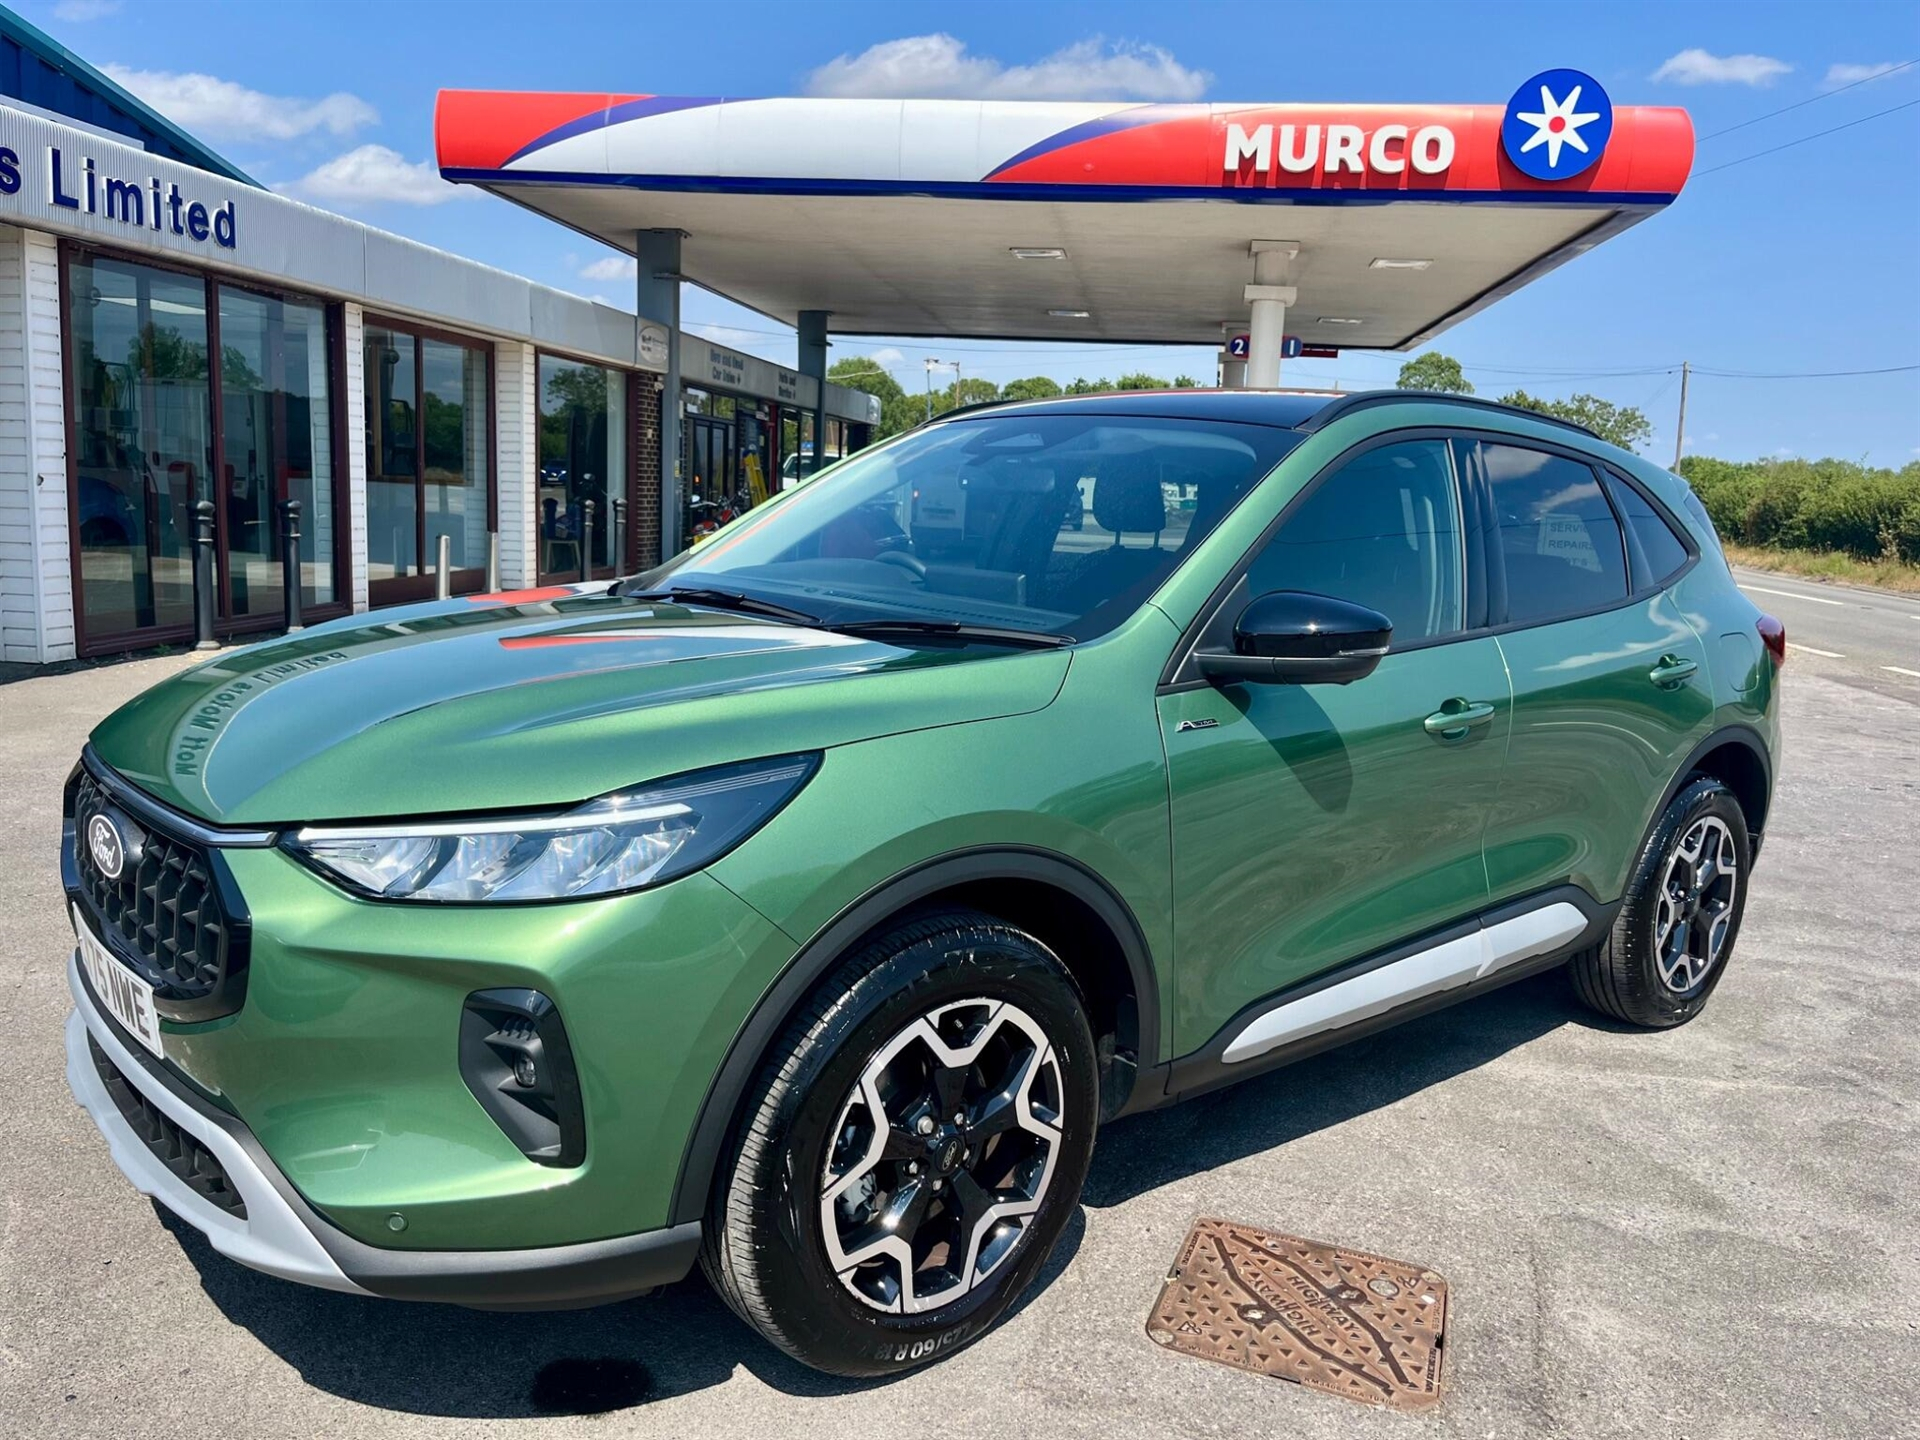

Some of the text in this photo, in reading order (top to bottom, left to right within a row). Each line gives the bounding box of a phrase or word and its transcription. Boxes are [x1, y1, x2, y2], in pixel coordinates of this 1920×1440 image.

[1223, 123, 1456, 174] MURCO
[48, 146, 237, 249] Limited
[1234, 339, 1245, 355] 2
[92, 822, 115, 869] Ford
[106, 960, 150, 1040] NWE
